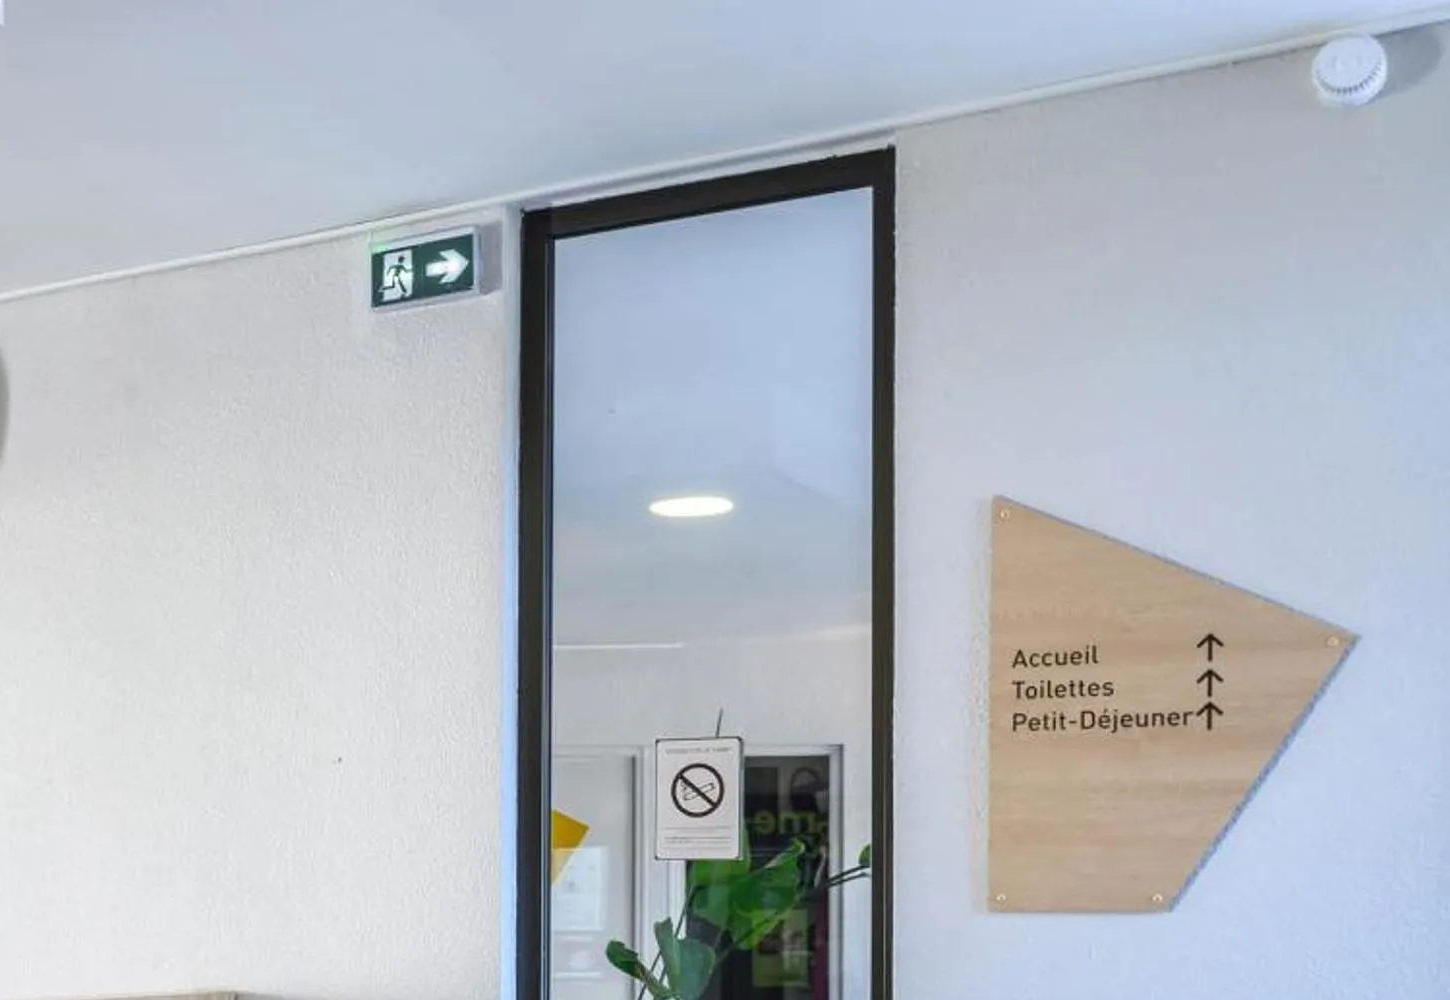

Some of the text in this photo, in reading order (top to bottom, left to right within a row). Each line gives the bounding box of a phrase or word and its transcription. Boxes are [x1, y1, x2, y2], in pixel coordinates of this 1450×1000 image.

[1012, 645, 1099, 668] Accueil
[1012, 680, 1115, 700] Toilettes
[1012, 708, 1194, 733] Petit-Déjeuner
